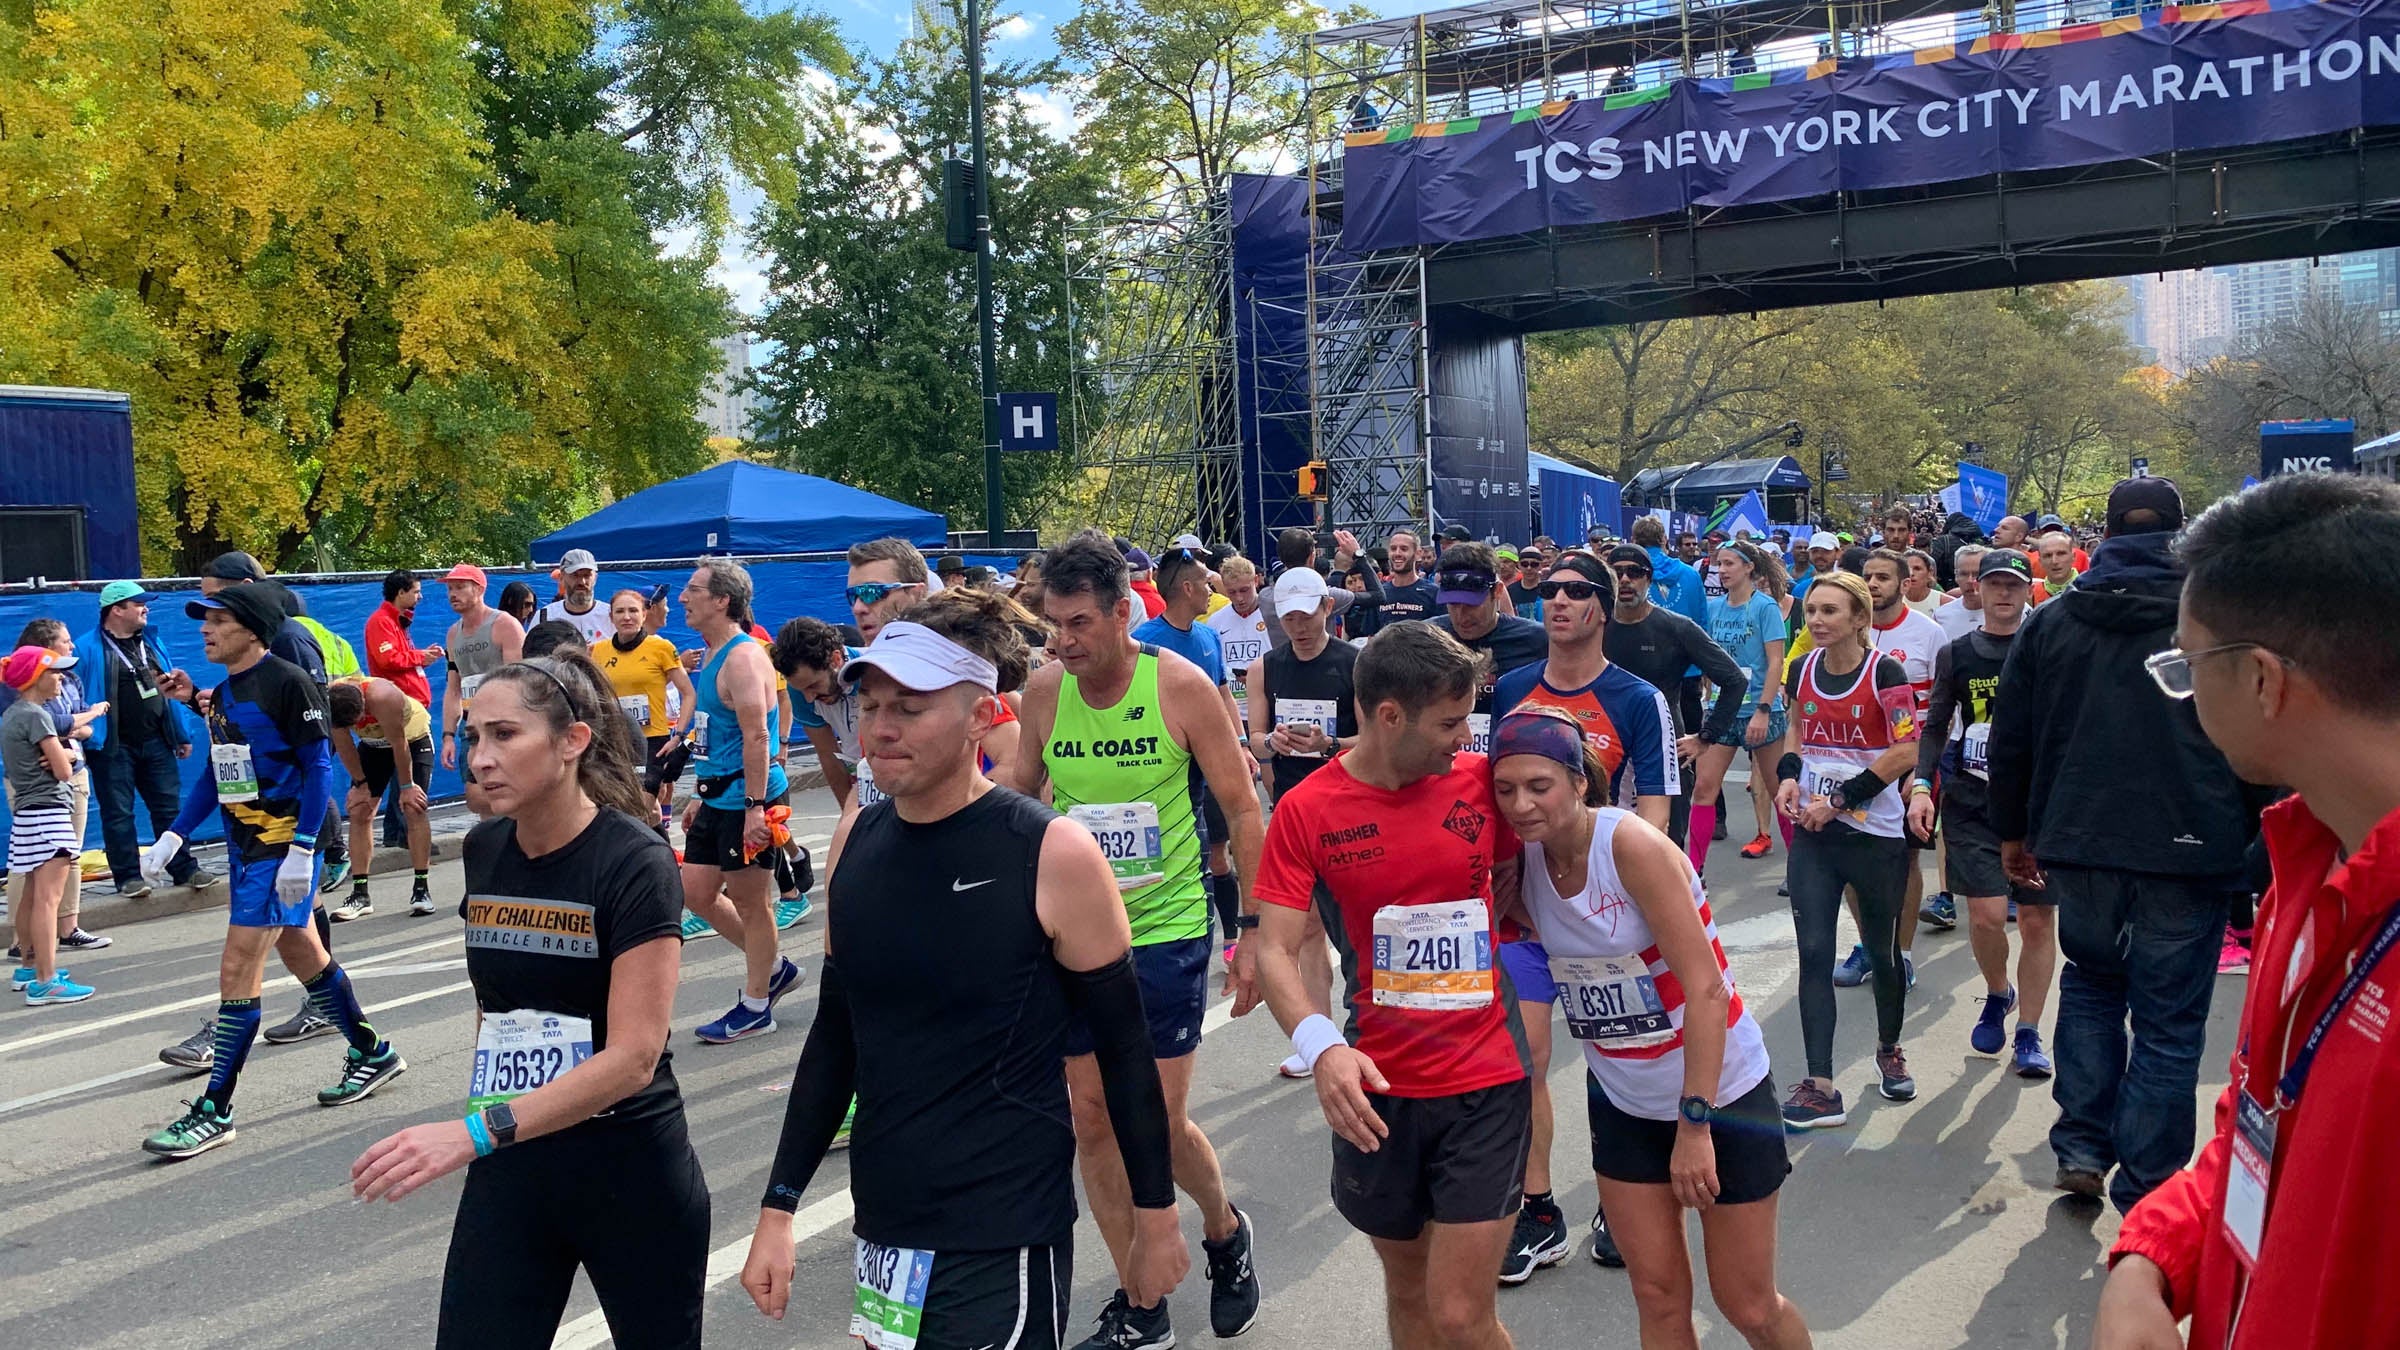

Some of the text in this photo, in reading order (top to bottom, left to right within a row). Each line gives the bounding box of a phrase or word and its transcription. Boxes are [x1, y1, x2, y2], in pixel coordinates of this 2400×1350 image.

[1515, 35, 2400, 190] TCS NEW YORK CITY MARATHON
[1013, 406, 1043, 438] H
[2283, 456, 2333, 473] NYC
[1396, 602, 1423, 612] RUNNERS
[1228, 642, 1258, 660] AIG
[1053, 736, 1158, 758] CAL COAST
[219, 762, 239, 781] 6015
[1116, 758, 1162, 768] TRACK CLUB
[1320, 823, 1380, 848] FINISHER
[1467, 854, 1486, 899] MAN
[468, 904, 493, 923] CITY
[496, 906, 591, 934] CHALLENGE
[1411, 911, 1430, 919] TATA
[542, 935, 593, 953] RACE
[1376, 938, 1388, 967] 2019
[1406, 936, 1460, 971] 2461
[1579, 983, 1626, 1017] 8317
[2365, 980, 2385, 999] TCS
[541, 1030, 563, 1039] TATA
[2306, 1024, 2323, 1051] TCS
[473, 1054, 486, 1093] 2019
[491, 1047, 563, 1092] 15632
[2246, 1102, 2264, 1130] 2019
[2233, 1134, 2268, 1186] MEDICAL
[892, 1312, 904, 1328] A
